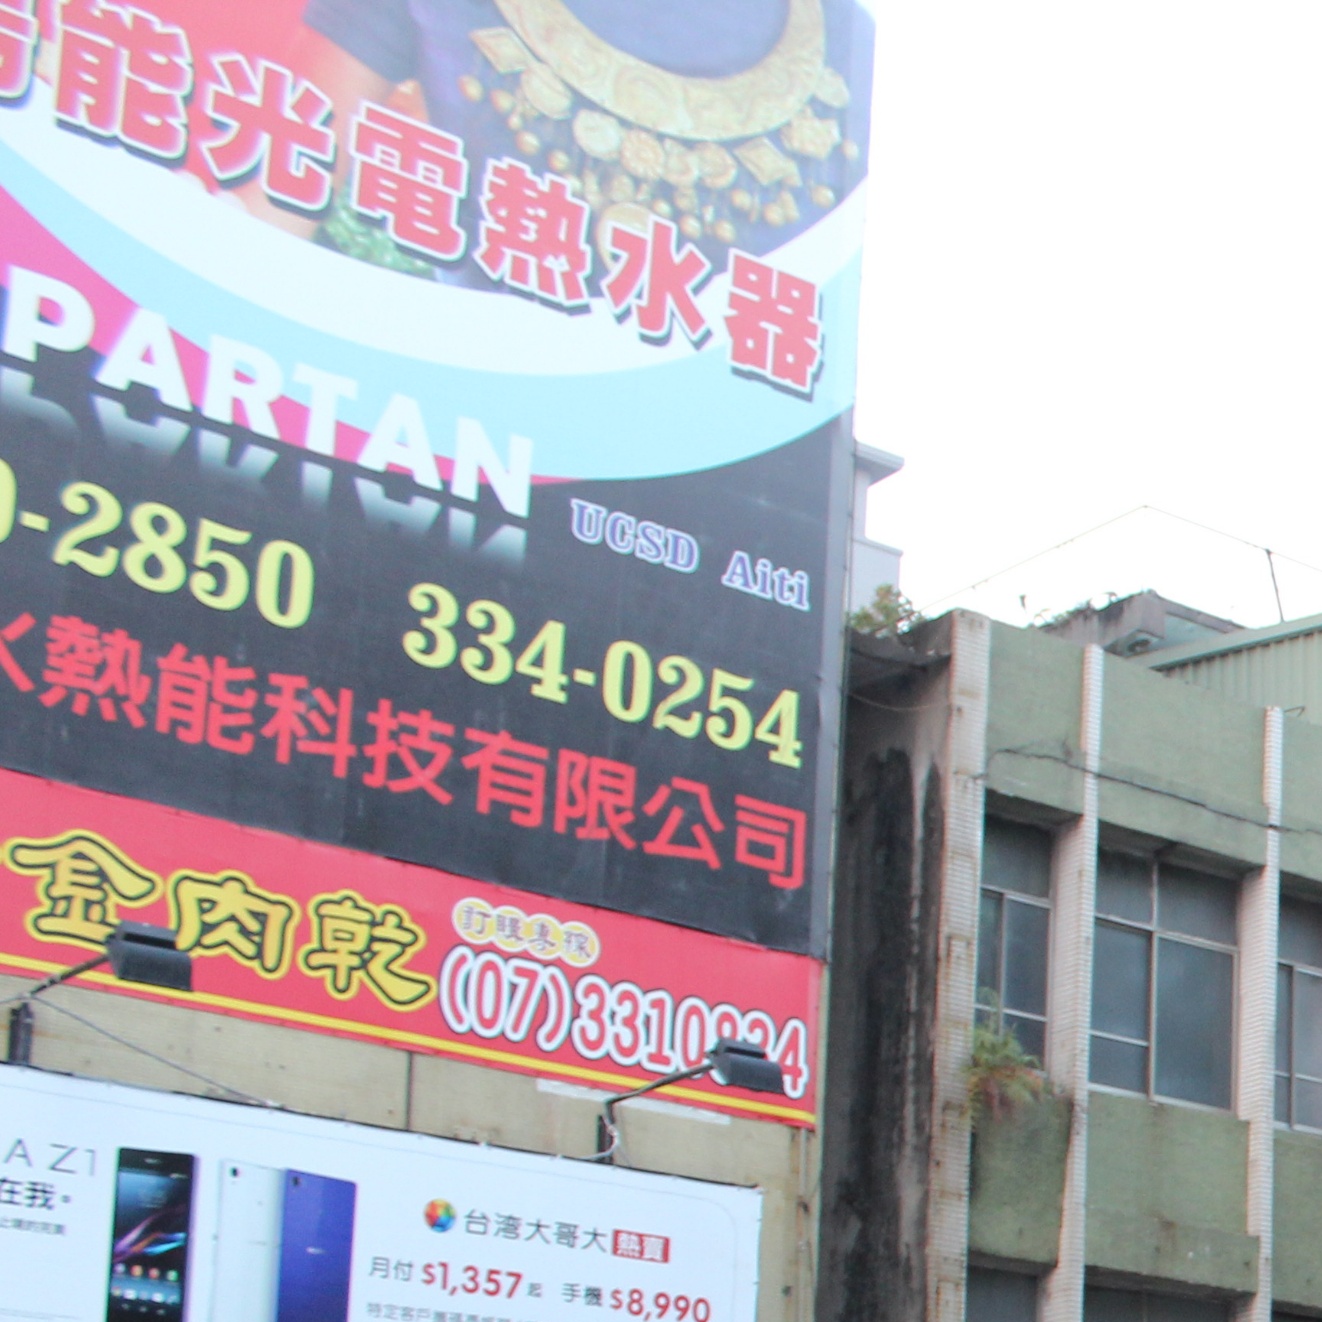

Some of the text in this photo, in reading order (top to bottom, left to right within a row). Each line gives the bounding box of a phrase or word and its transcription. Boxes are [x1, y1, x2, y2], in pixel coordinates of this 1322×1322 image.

[0, 0, 821, 389] 能光電熱水器
[570, 498, 699, 573] UCSD
[402, 583, 802, 769] 334-0254
[48, 1143, 97, 1177] Z1
[369, 1256, 414, 1282] 月付
[421, 1262, 524, 1299] $1,357
[561, 1282, 604, 1308] 手機
